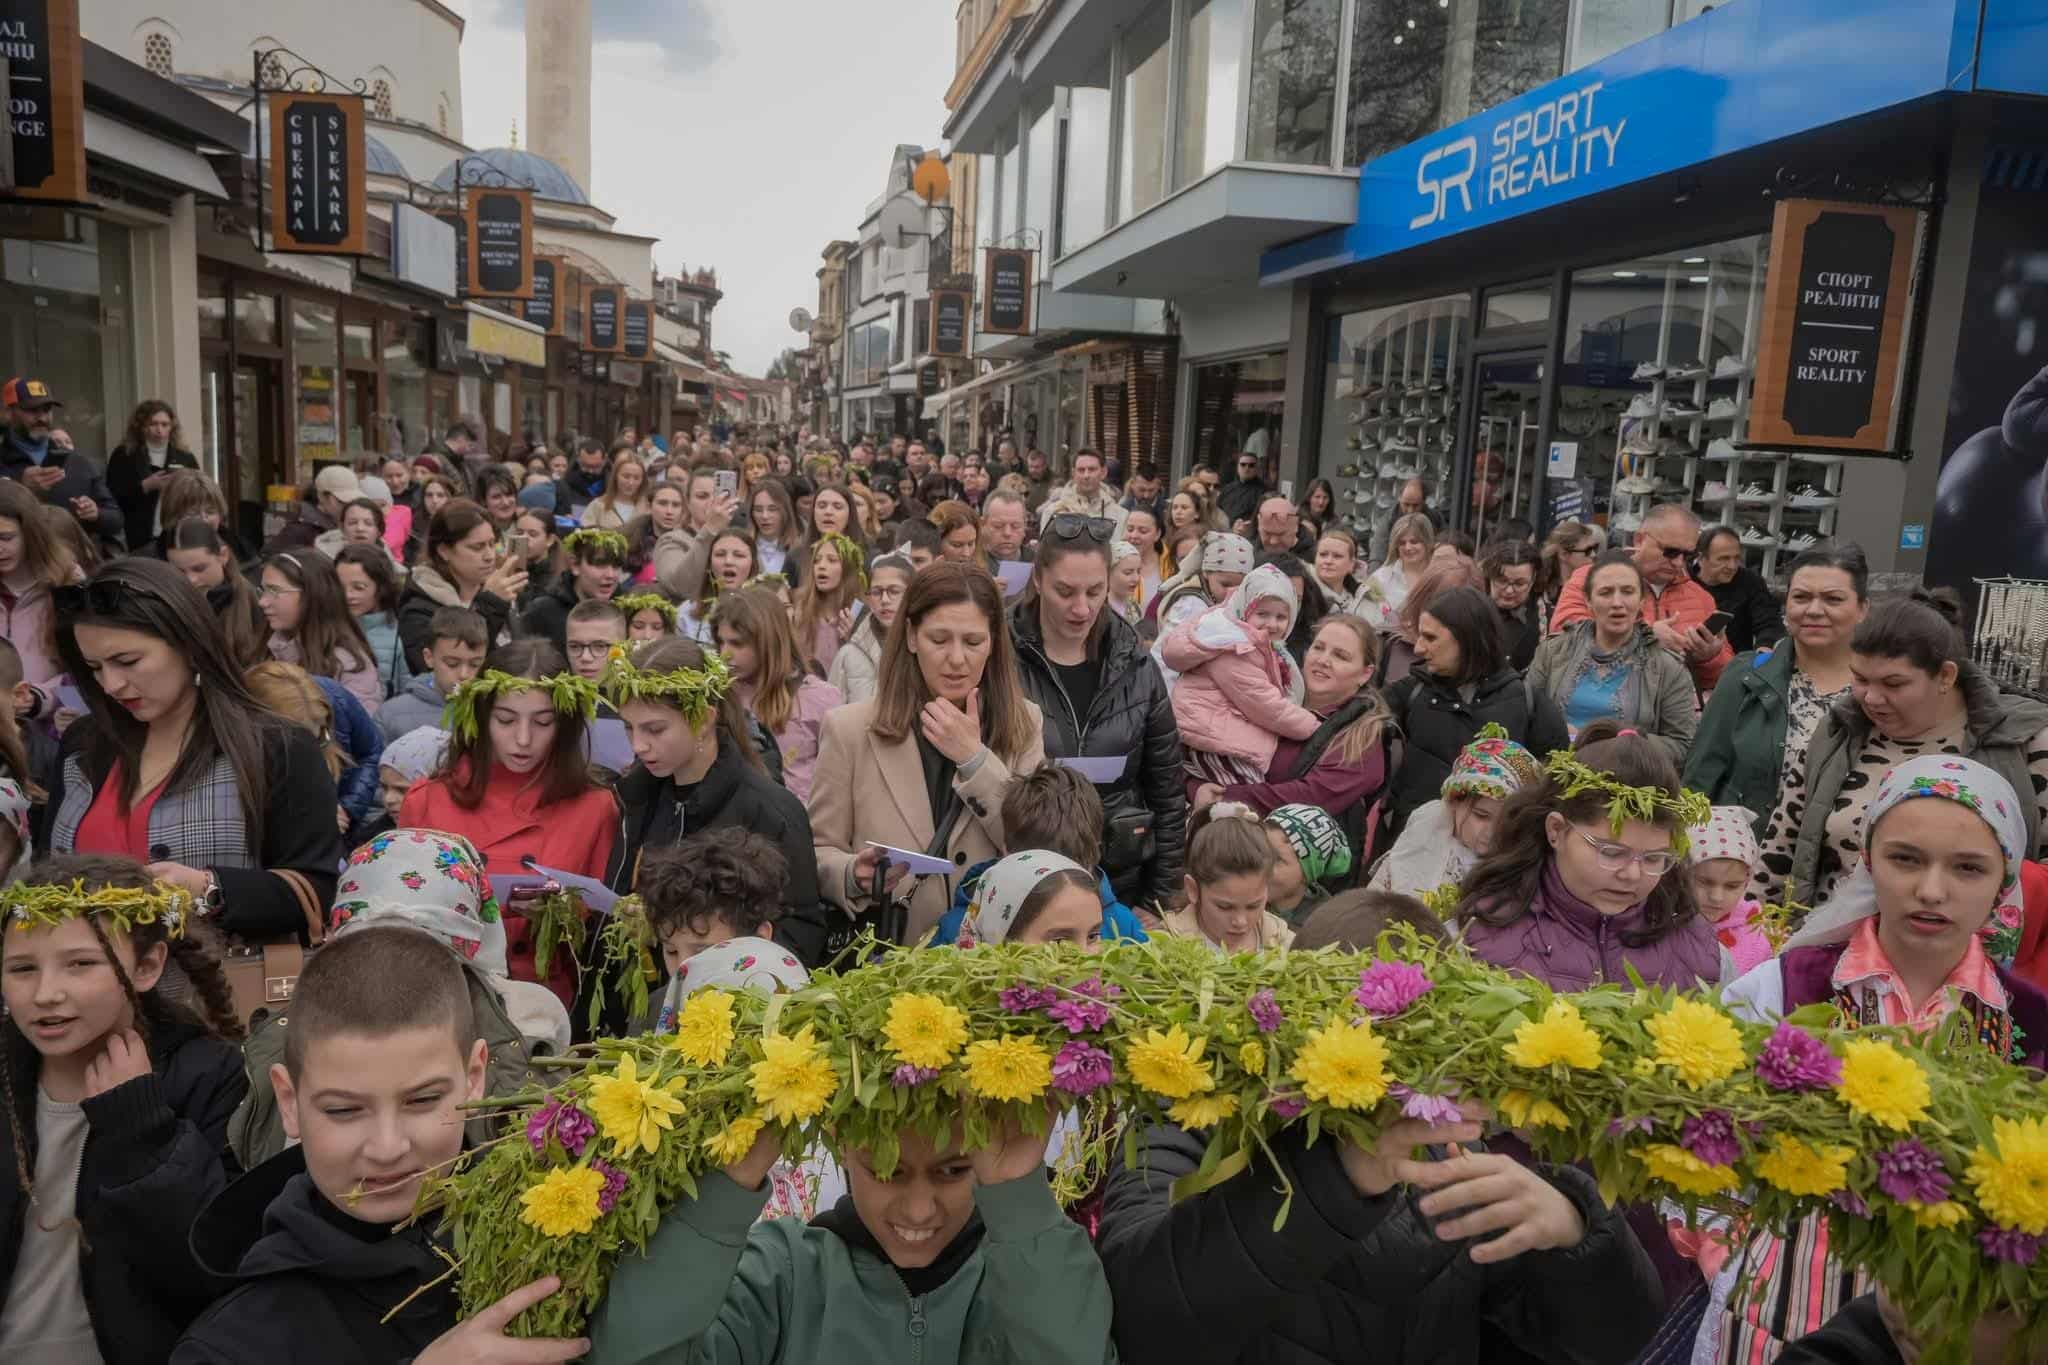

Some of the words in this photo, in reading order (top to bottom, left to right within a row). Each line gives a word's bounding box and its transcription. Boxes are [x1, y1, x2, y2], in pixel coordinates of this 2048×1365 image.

[1488, 117, 1627, 205] REALITY
[1492, 82, 1603, 163] SPORT
[289, 114, 304, 231] СВЕКАРА
[327, 114, 341, 233] SVEKARA
[1409, 136, 1477, 230] SR
[1804, 290, 1880, 309] РЕАЛИТИ
[1817, 271, 1873, 289] СПОРТ
[1796, 366, 1867, 384] REALITY
[1808, 347, 1860, 364] SPORT
